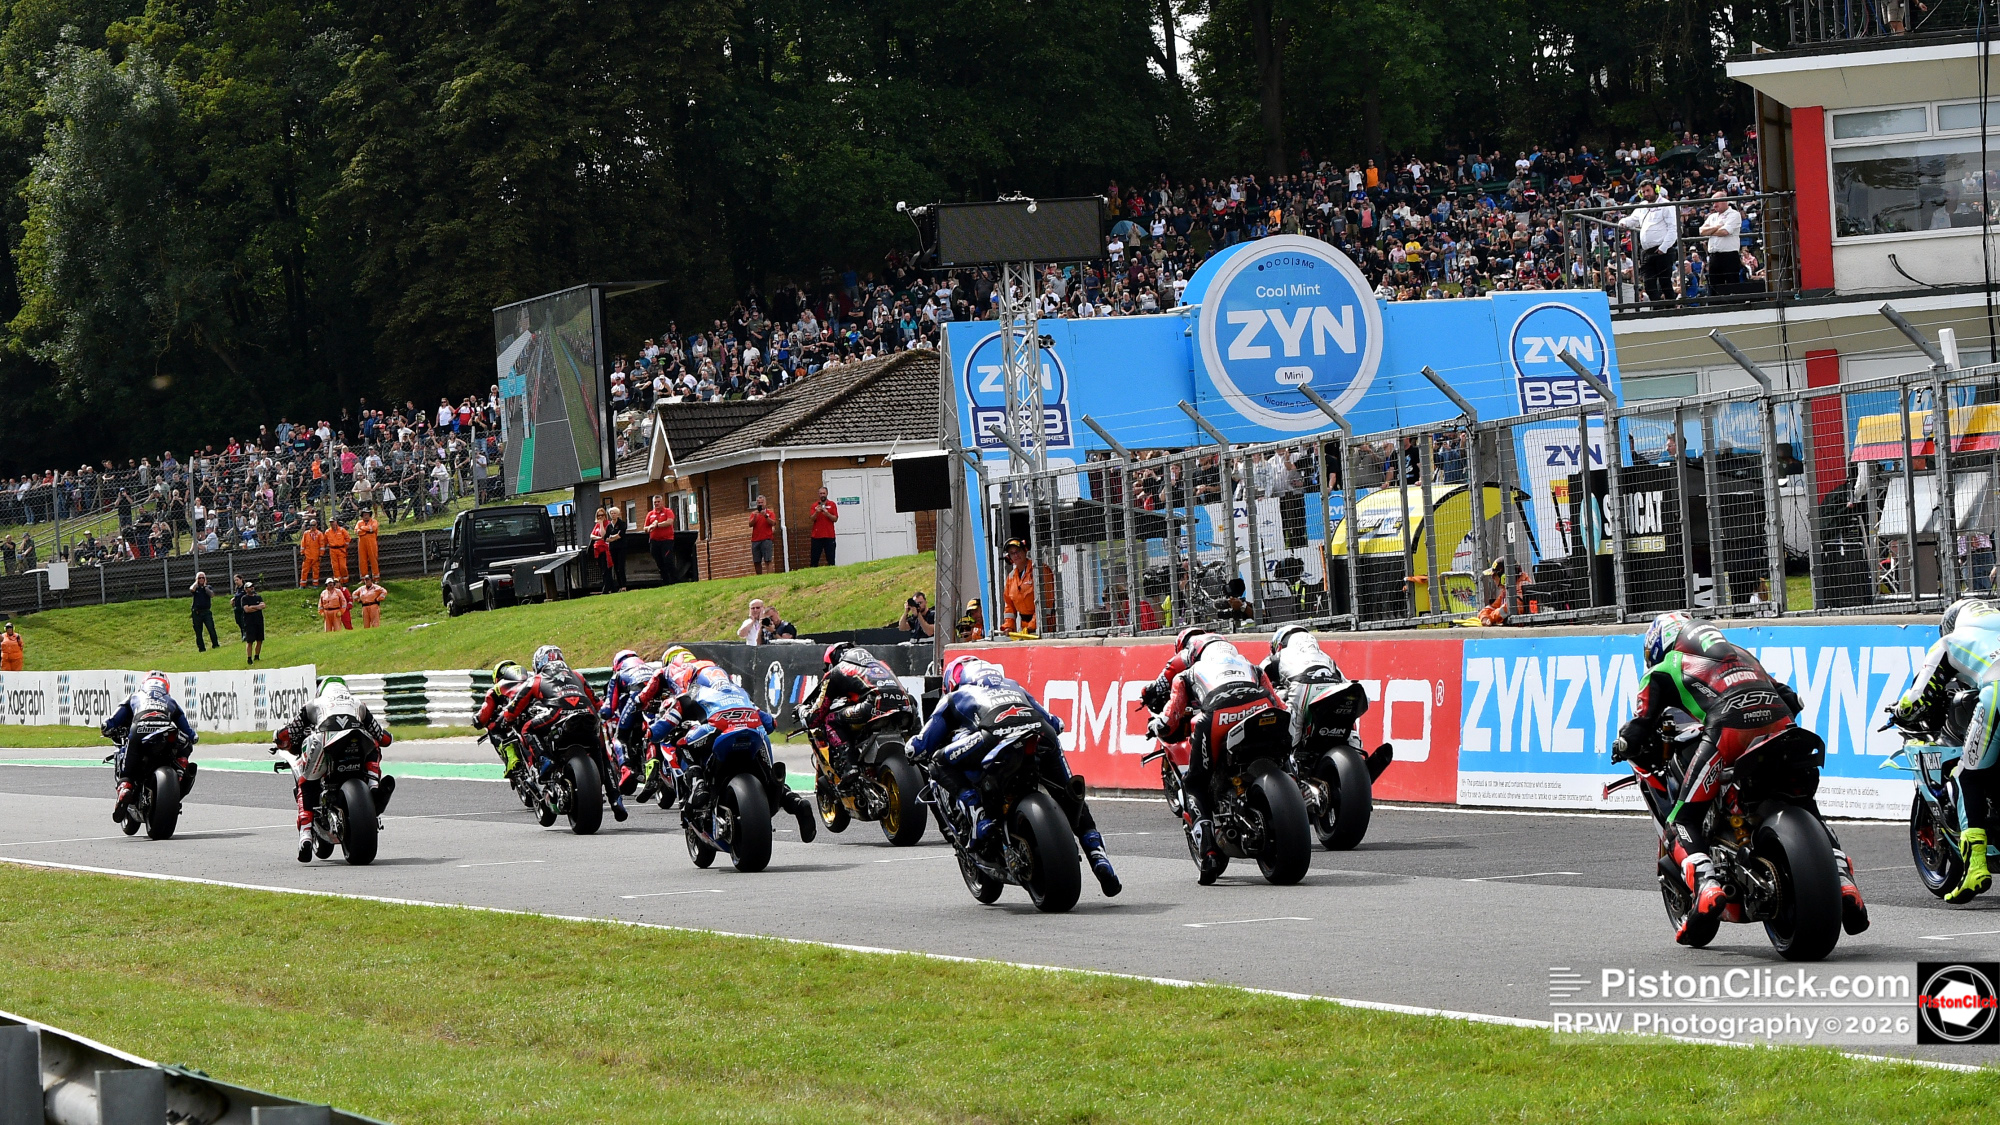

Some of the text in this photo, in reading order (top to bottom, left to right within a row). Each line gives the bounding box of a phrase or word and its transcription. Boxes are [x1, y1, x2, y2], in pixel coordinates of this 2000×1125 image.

[1302, 259, 1315, 269] MG
[1256, 283, 1321, 298] Cool Mint
[1227, 305, 1357, 360] ZYN
[1522, 336, 1594, 363] ZYN
[1284, 371, 1304, 380] Mini
[1233, 507, 1248, 518] ZY
[1509, 527, 1514, 538] 2
[1723, 671, 1758, 687] DUCATI
[1691, 682, 1719, 699] RST
[7, 679, 46, 725] xograph
[72, 678, 112, 725] xograph
[200, 680, 239, 731] xograph
[269, 676, 309, 727] xograph
[1721, 691, 1779, 714] RST
[717, 710, 755, 721] RST
[992, 722, 1042, 736] alpinestars
[1702, 757, 1723, 795] RST
